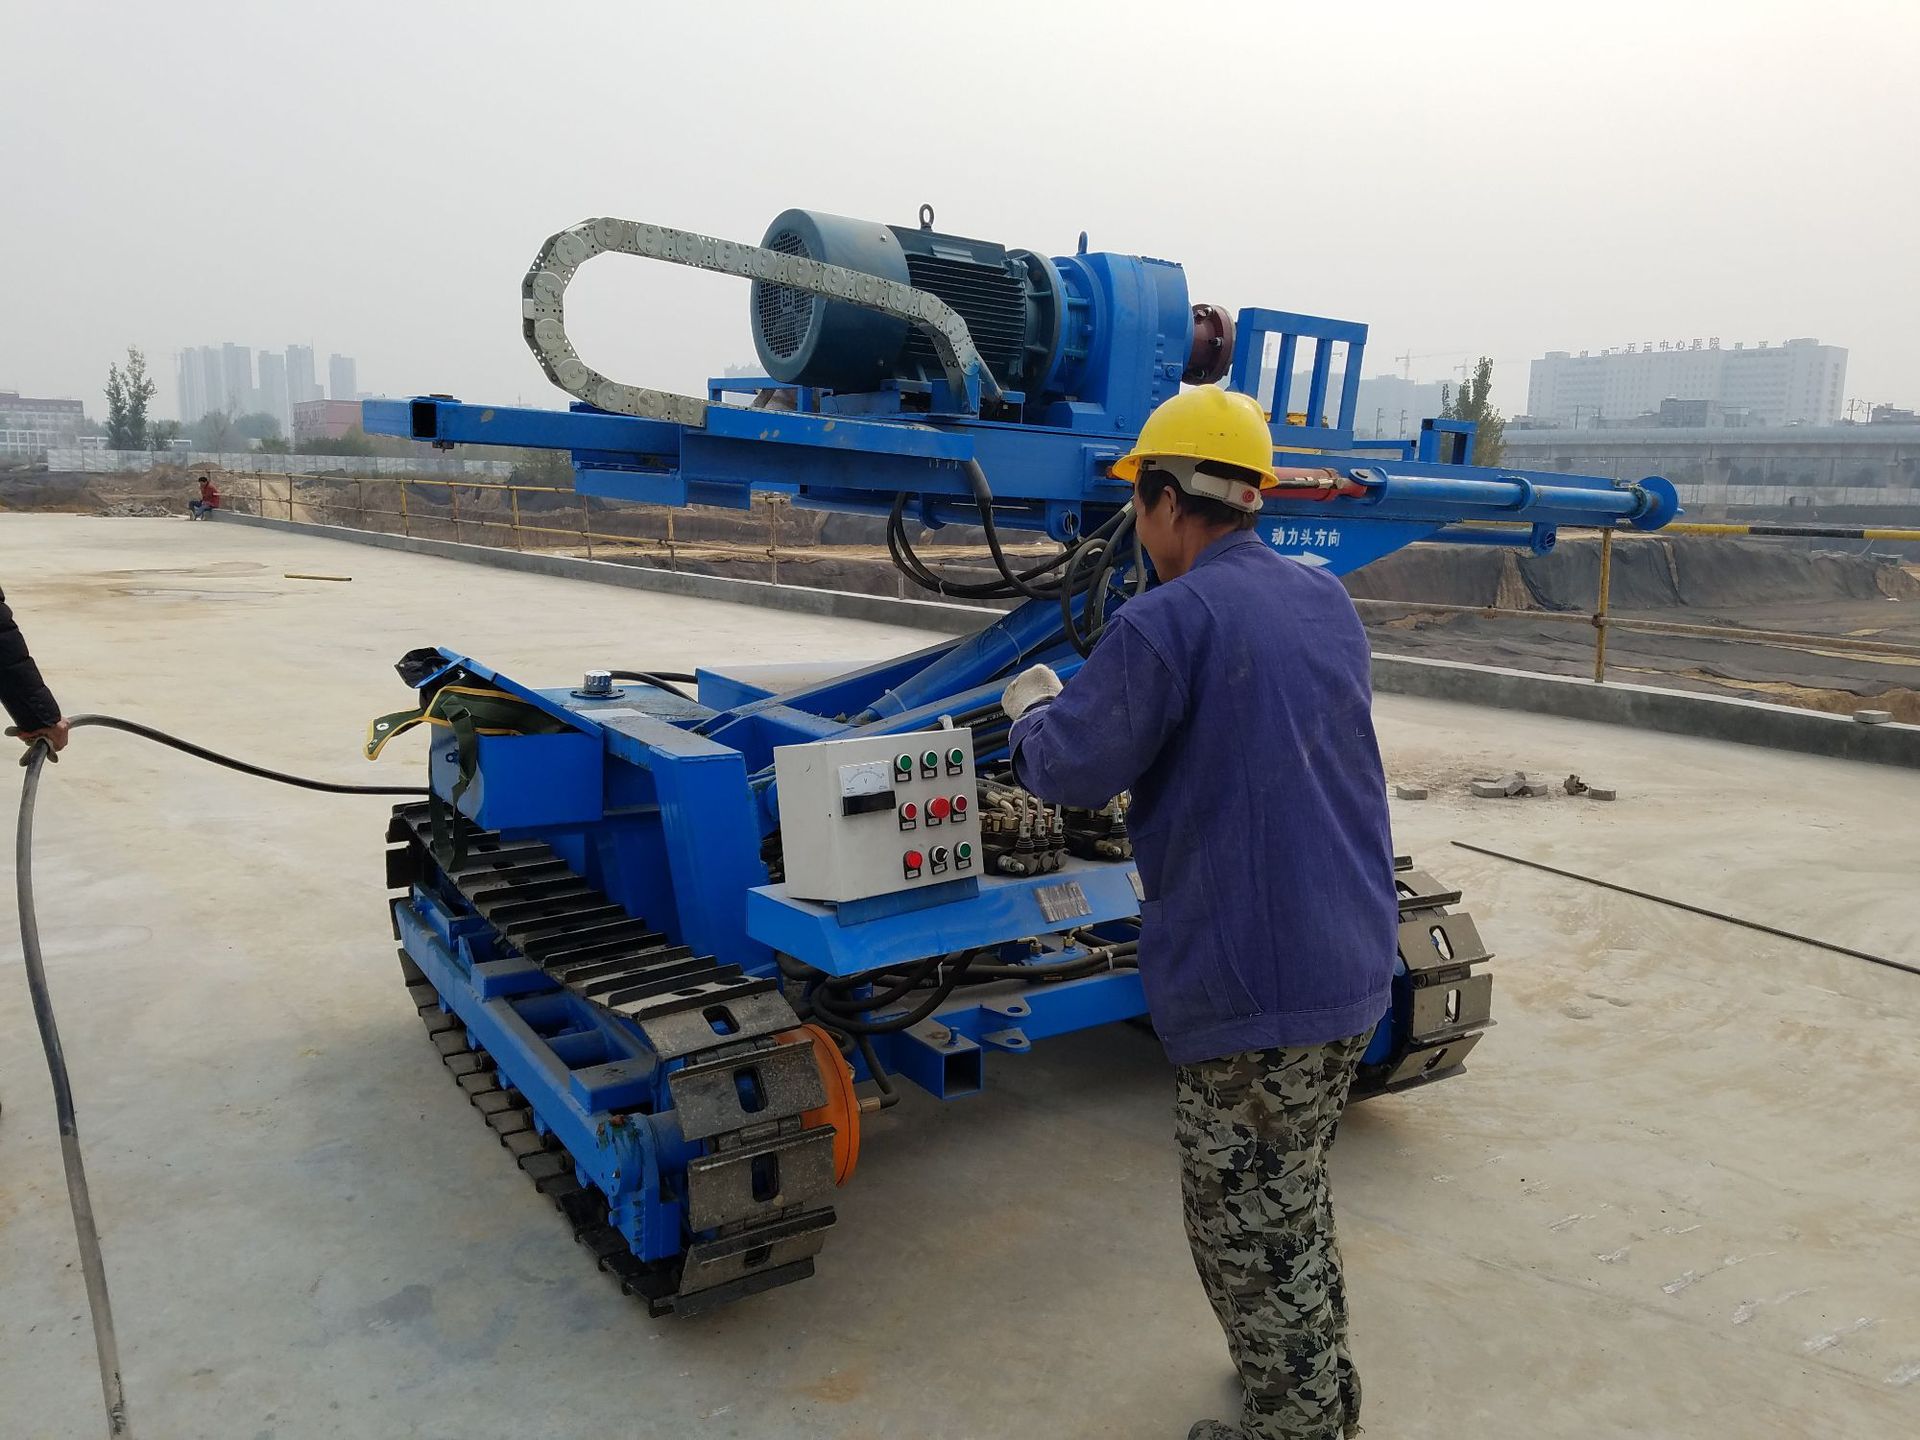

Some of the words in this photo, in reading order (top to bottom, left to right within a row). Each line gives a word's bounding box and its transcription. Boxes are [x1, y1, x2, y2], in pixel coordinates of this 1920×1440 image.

[1271, 526, 1341, 547] 动力头方向
